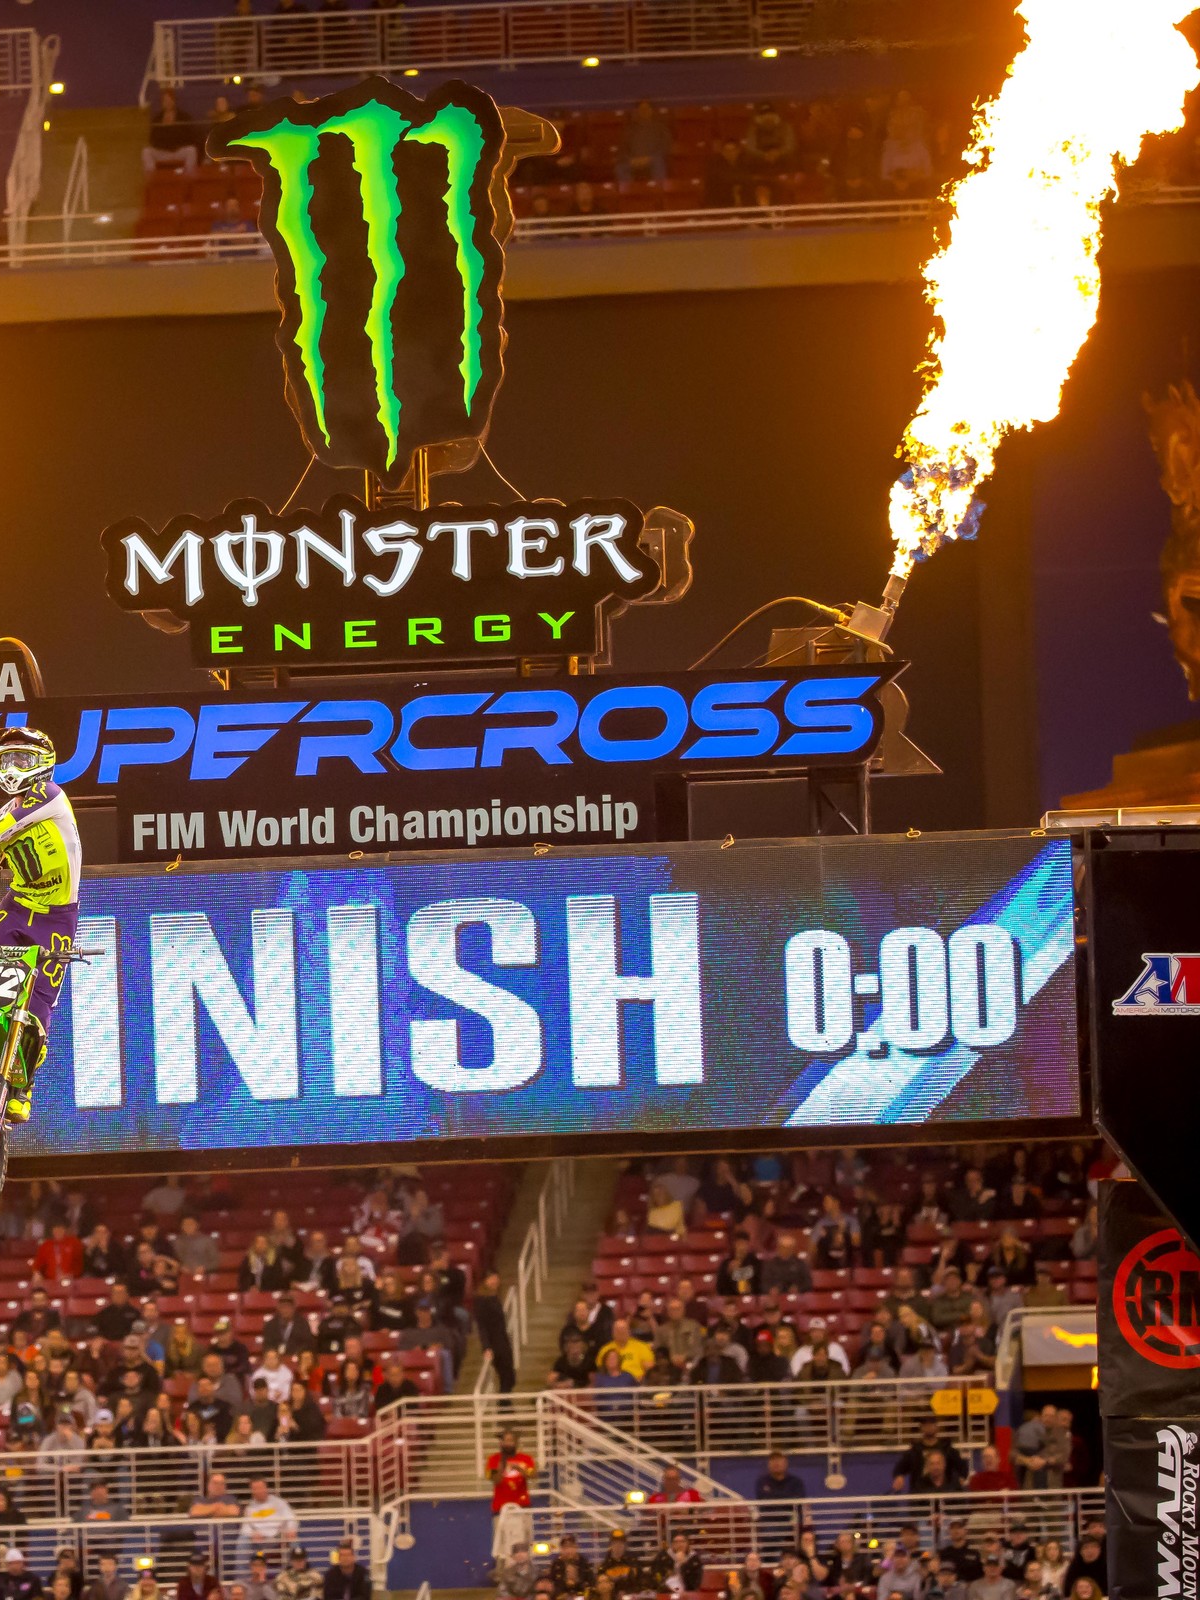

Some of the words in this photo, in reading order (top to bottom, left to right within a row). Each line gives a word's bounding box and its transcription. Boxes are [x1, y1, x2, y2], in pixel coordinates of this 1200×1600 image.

[121, 509, 644, 606] MONSTER
[211, 611, 576, 654] ENERGY
[133, 811, 205, 851] FIM
[219, 807, 335, 847] World
[349, 794, 639, 846] Championship
[1182, 1459, 1200, 1530] ROCKY
